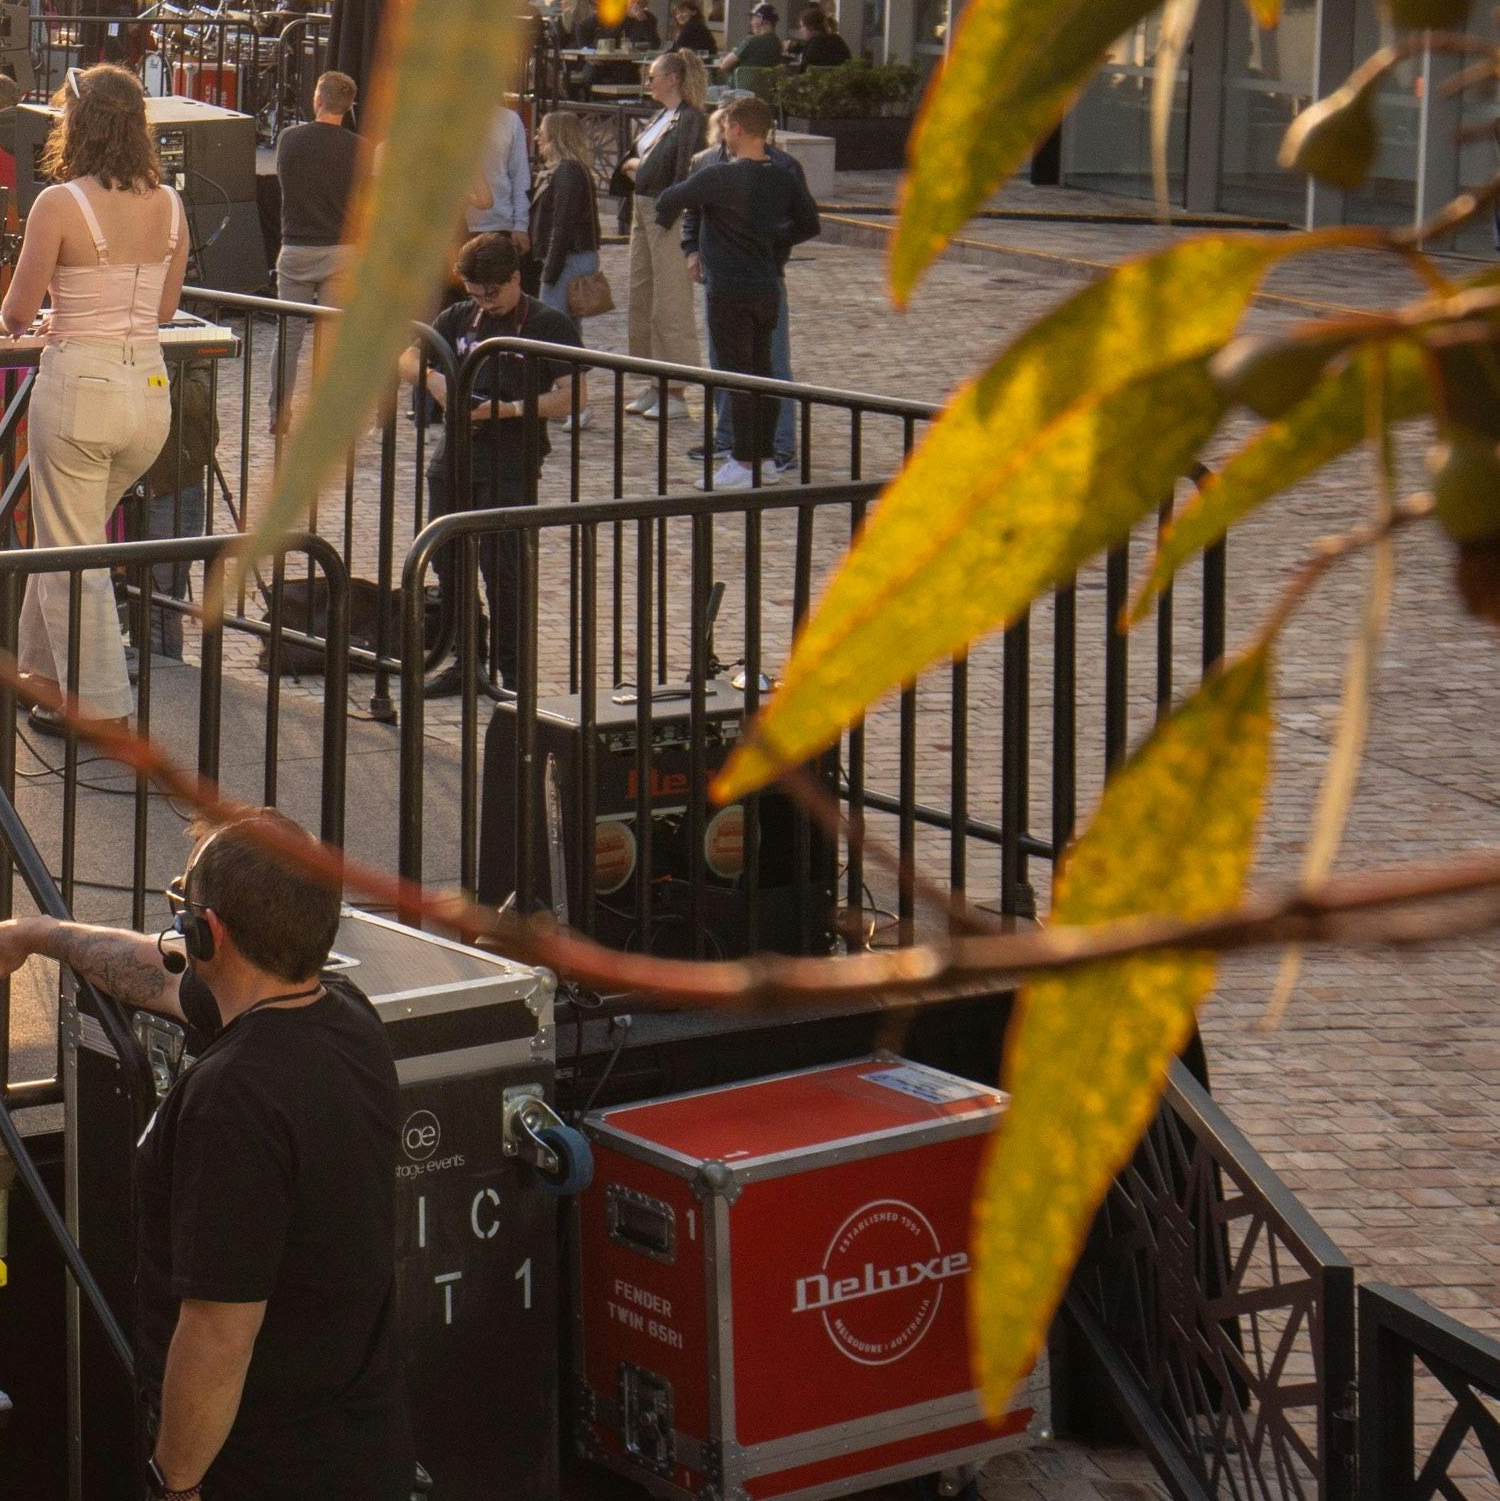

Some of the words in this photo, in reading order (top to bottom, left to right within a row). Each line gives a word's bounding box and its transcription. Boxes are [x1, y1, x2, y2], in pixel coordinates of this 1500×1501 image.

[396, 1163, 425, 1180] tage
[426, 1154, 466, 1172] events
[686, 1208, 696, 1241] 1
[838, 1212, 898, 1253] ESTABLISHED
[515, 1258, 531, 1309] 1
[615, 1279, 672, 1318] FENDER
[792, 1252, 972, 1313] Deluxe
[607, 1301, 644, 1332] TWIN
[834, 1318, 883, 1353] MELBOURNE
[890, 1299, 930, 1349] AUSTRALIA
